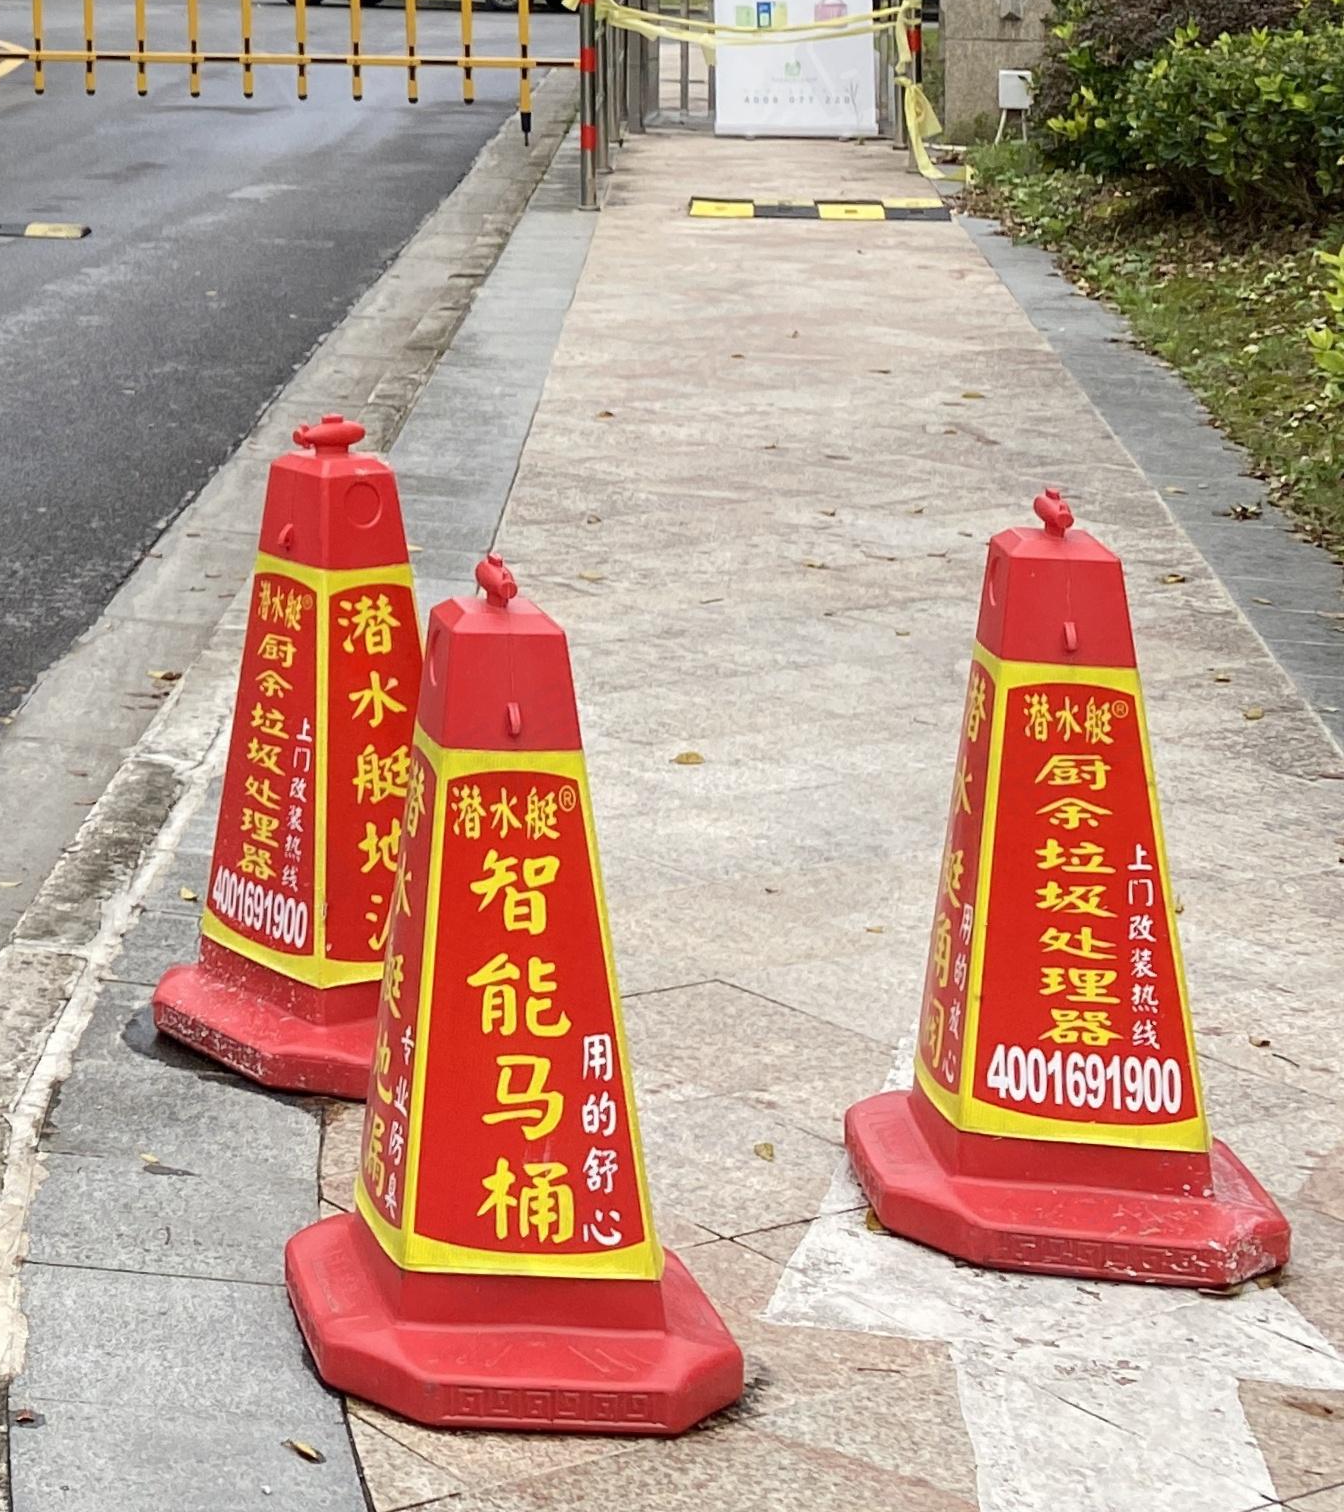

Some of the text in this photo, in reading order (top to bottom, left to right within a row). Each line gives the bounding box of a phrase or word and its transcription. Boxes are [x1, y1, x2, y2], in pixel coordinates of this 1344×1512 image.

[257, 580, 302, 631] 潜水艇
[235, 632, 297, 881] 厨余垃圾处理器
[280, 717, 313, 893] 上门改装热线
[1023, 692, 1114, 745] 潜水艇
[451, 784, 561, 841] 潜水艇
[1035, 754, 1124, 1047] 厨余垃圾处理器
[212, 864, 309, 950] 4001691900
[1126, 843, 1161, 1051] 上门改装热线
[466, 848, 575, 1245] 智能马桶
[986, 1043, 1183, 1115] 4001691900
[581, 1032, 623, 1246] 用的舒心
